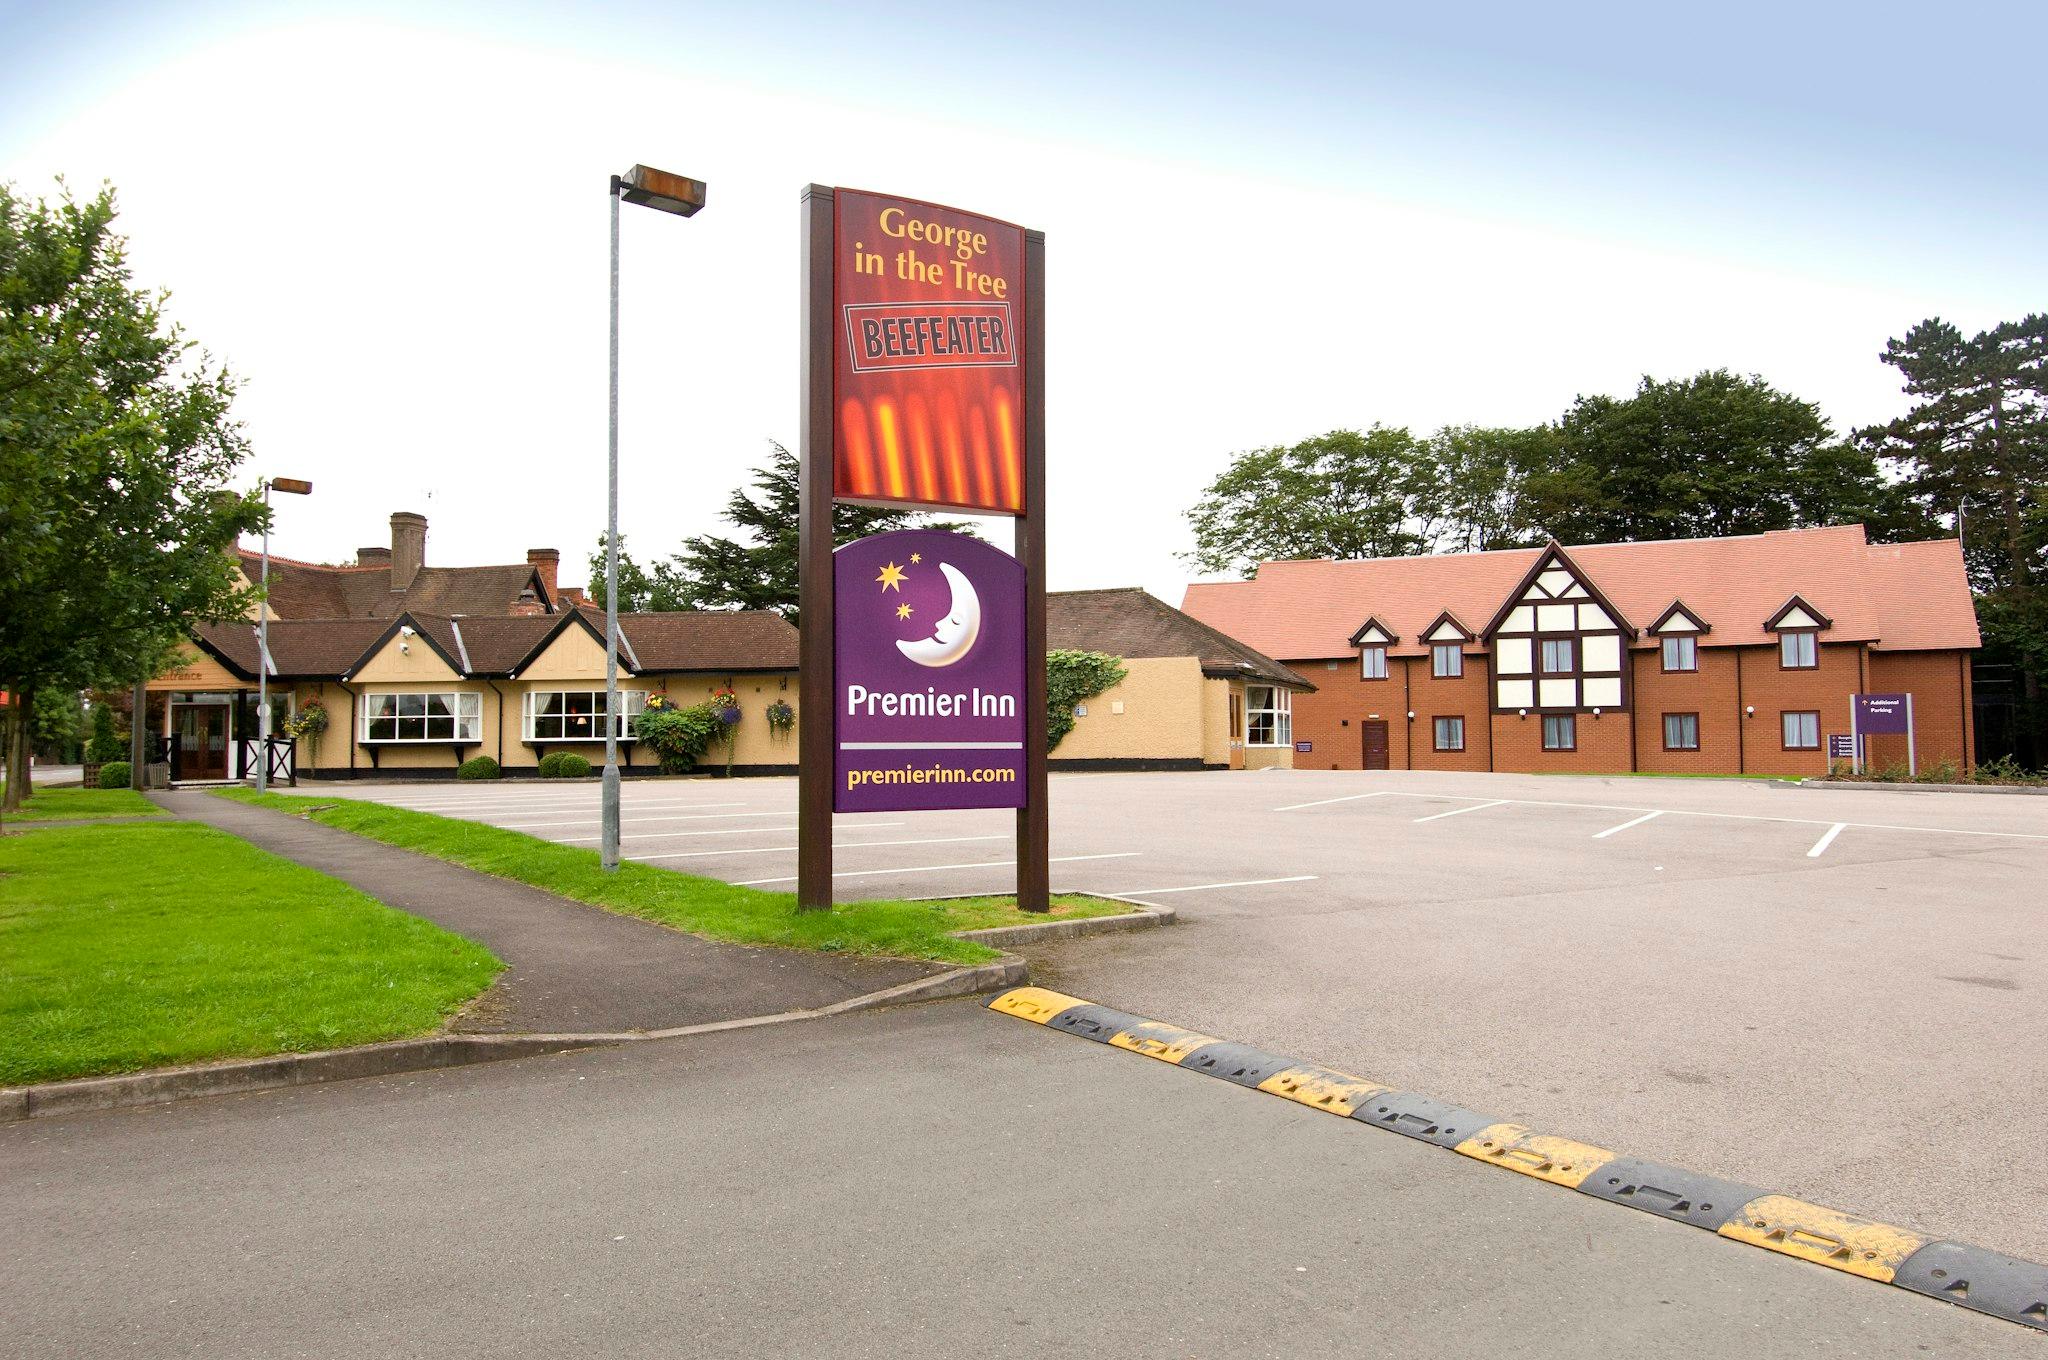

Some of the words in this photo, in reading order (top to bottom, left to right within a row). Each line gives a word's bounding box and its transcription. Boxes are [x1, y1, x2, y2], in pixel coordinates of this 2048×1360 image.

[879, 207, 988, 260] George
[855, 242, 884, 276] in
[896, 250, 943, 285] the
[950, 260, 1007, 299] Tree
[861, 315, 1008, 359] BEEFEATER
[848, 684, 967, 717] Premier
[972, 687, 1016, 717] Inn
[847, 763, 1016, 791] premierinn.com
